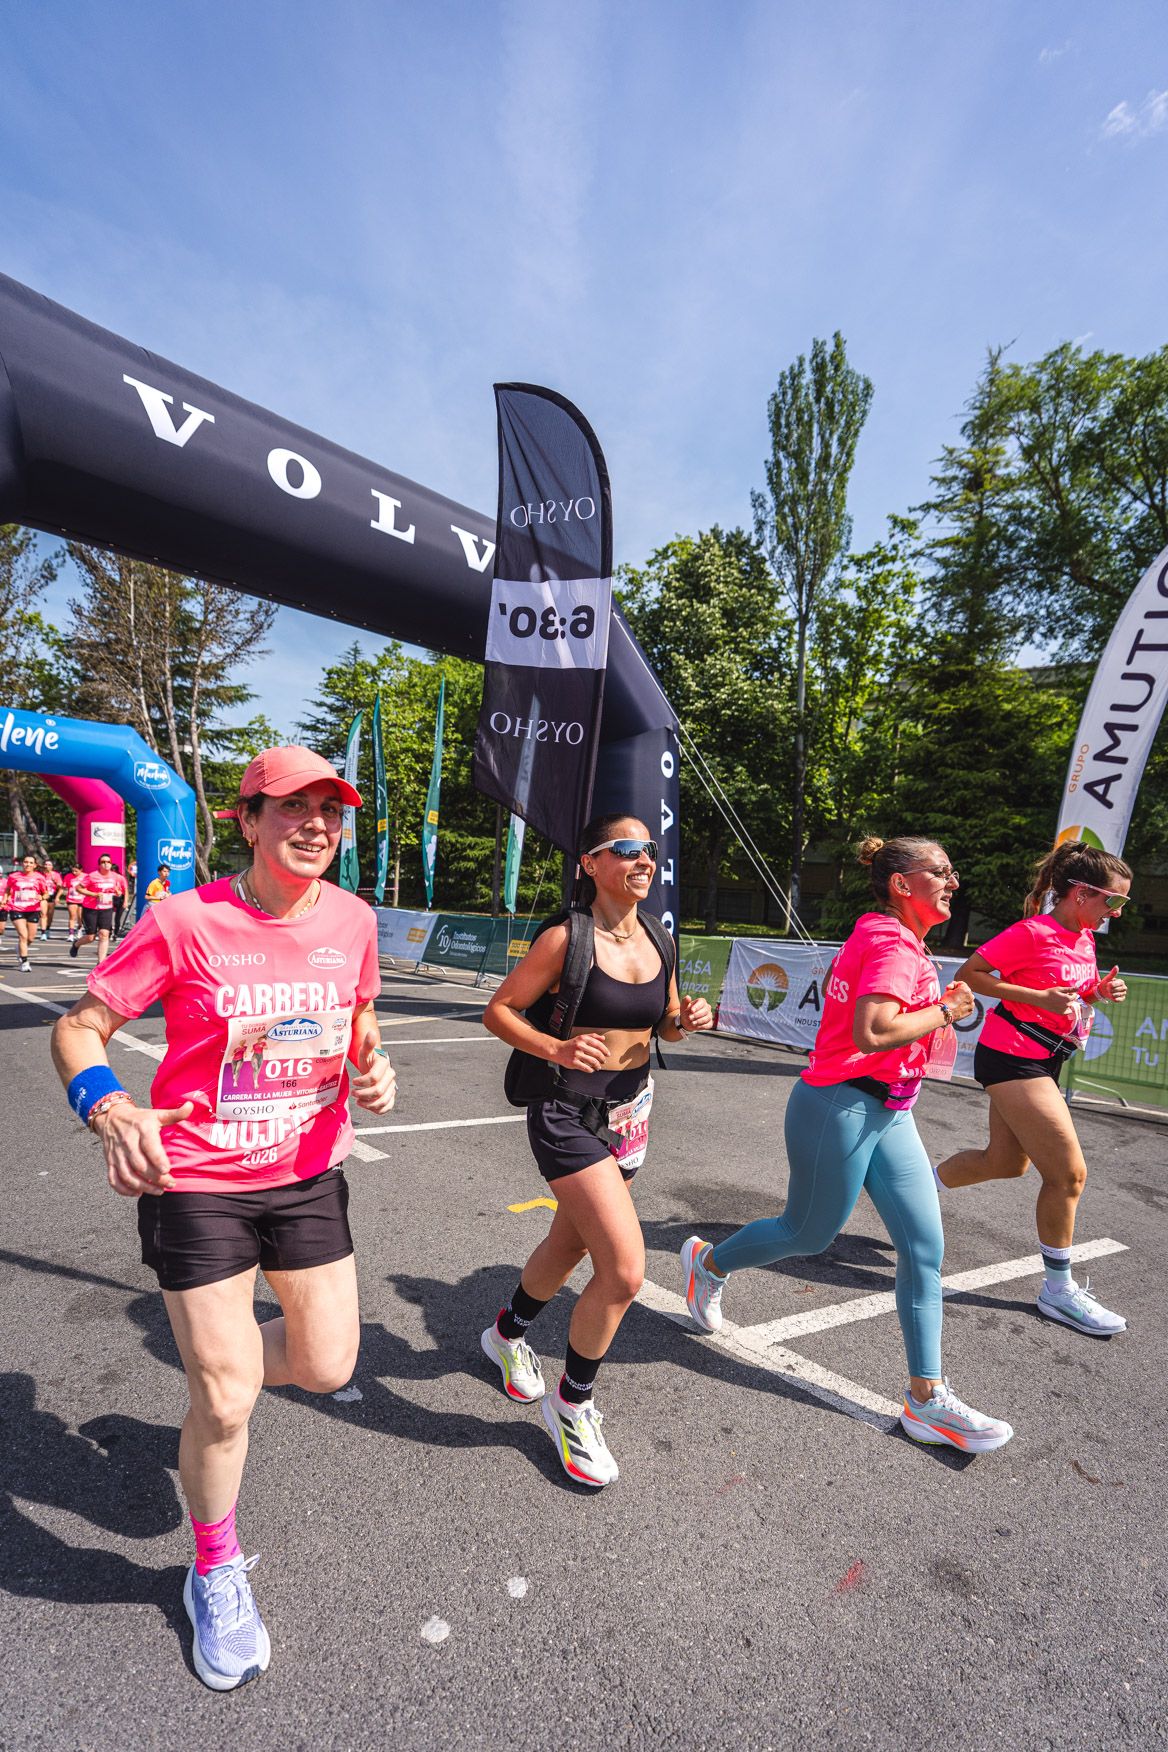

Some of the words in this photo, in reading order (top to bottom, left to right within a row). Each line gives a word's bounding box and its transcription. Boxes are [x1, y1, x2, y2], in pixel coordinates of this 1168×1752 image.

[0, 712, 59, 755] lene
[1068, 743, 1090, 793] GRUPO
[660, 750, 675, 937] OLVO
[208, 952, 266, 967] OYSHO
[215, 982, 340, 1017] CARRERA
[242, 1026, 267, 1035] SUMA
[271, 1028, 318, 1037] ASTURIANA
[265, 1059, 313, 1079] 016
[281, 1080, 298, 1088] 166
[222, 1092, 253, 1101] CARRERA
[253, 1092, 264, 1100] DE
[263, 1091, 272, 1099] LA
[272, 1089, 292, 1098] MUJER
[232, 1105, 275, 1115] OYSHO
[241, 1148, 278, 1165] 2026
